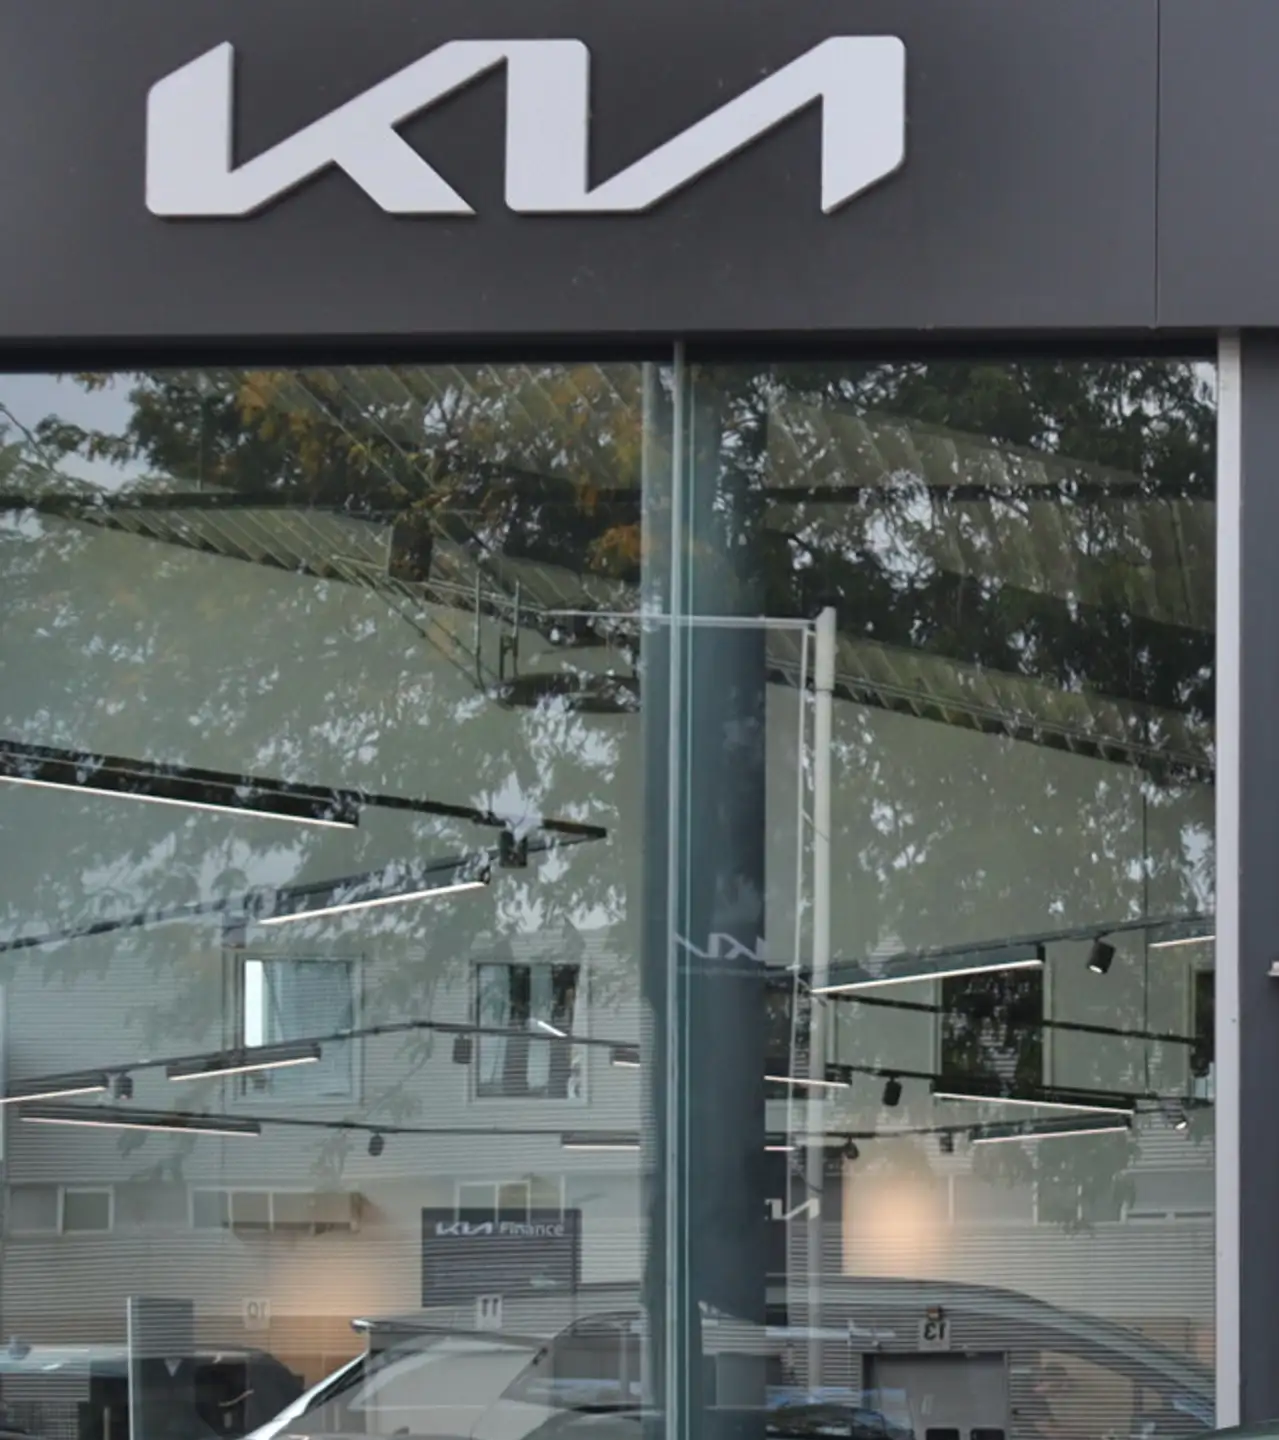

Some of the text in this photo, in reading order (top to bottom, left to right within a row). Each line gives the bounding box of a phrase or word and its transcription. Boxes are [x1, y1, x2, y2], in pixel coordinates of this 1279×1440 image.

[146, 35, 907, 217] KIA
[764, 1198, 820, 1220] IA
[435, 1221, 565, 1237] KIA Finance
